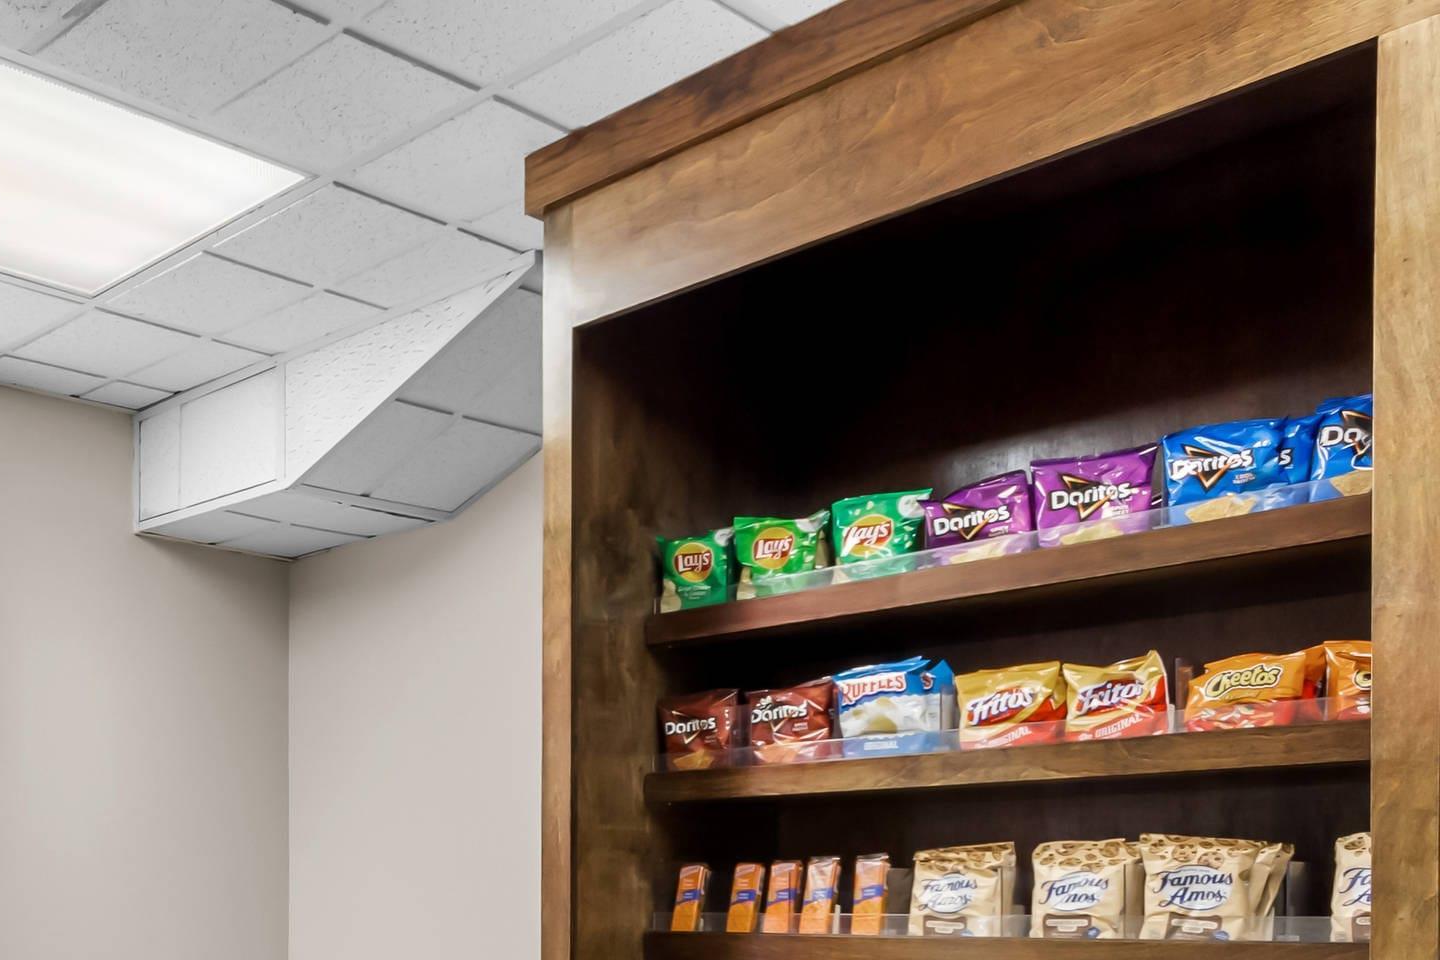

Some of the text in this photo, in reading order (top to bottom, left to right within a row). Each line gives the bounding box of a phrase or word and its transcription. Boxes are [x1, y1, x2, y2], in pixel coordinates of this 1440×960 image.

[1171, 448, 1254, 480] Doritos
[1050, 482, 1131, 511] Doritos
[932, 504, 1010, 536] Doritos
[756, 536, 793, 562] Lay's
[842, 519, 893, 557] Lay's
[676, 551, 711, 576] Lay's
[839, 671, 907, 705] RUFFLES
[1205, 664, 1282, 699] Cheetos
[966, 686, 1037, 726] Fritos
[665, 716, 716, 736] Doritos
[1095, 713, 1143, 739] ORIGINAL
[920, 877, 978, 895] Famous
[1039, 875, 1111, 905] Famous
[1153, 869, 1234, 895] Famous
[1158, 886, 1228, 909] Amos
